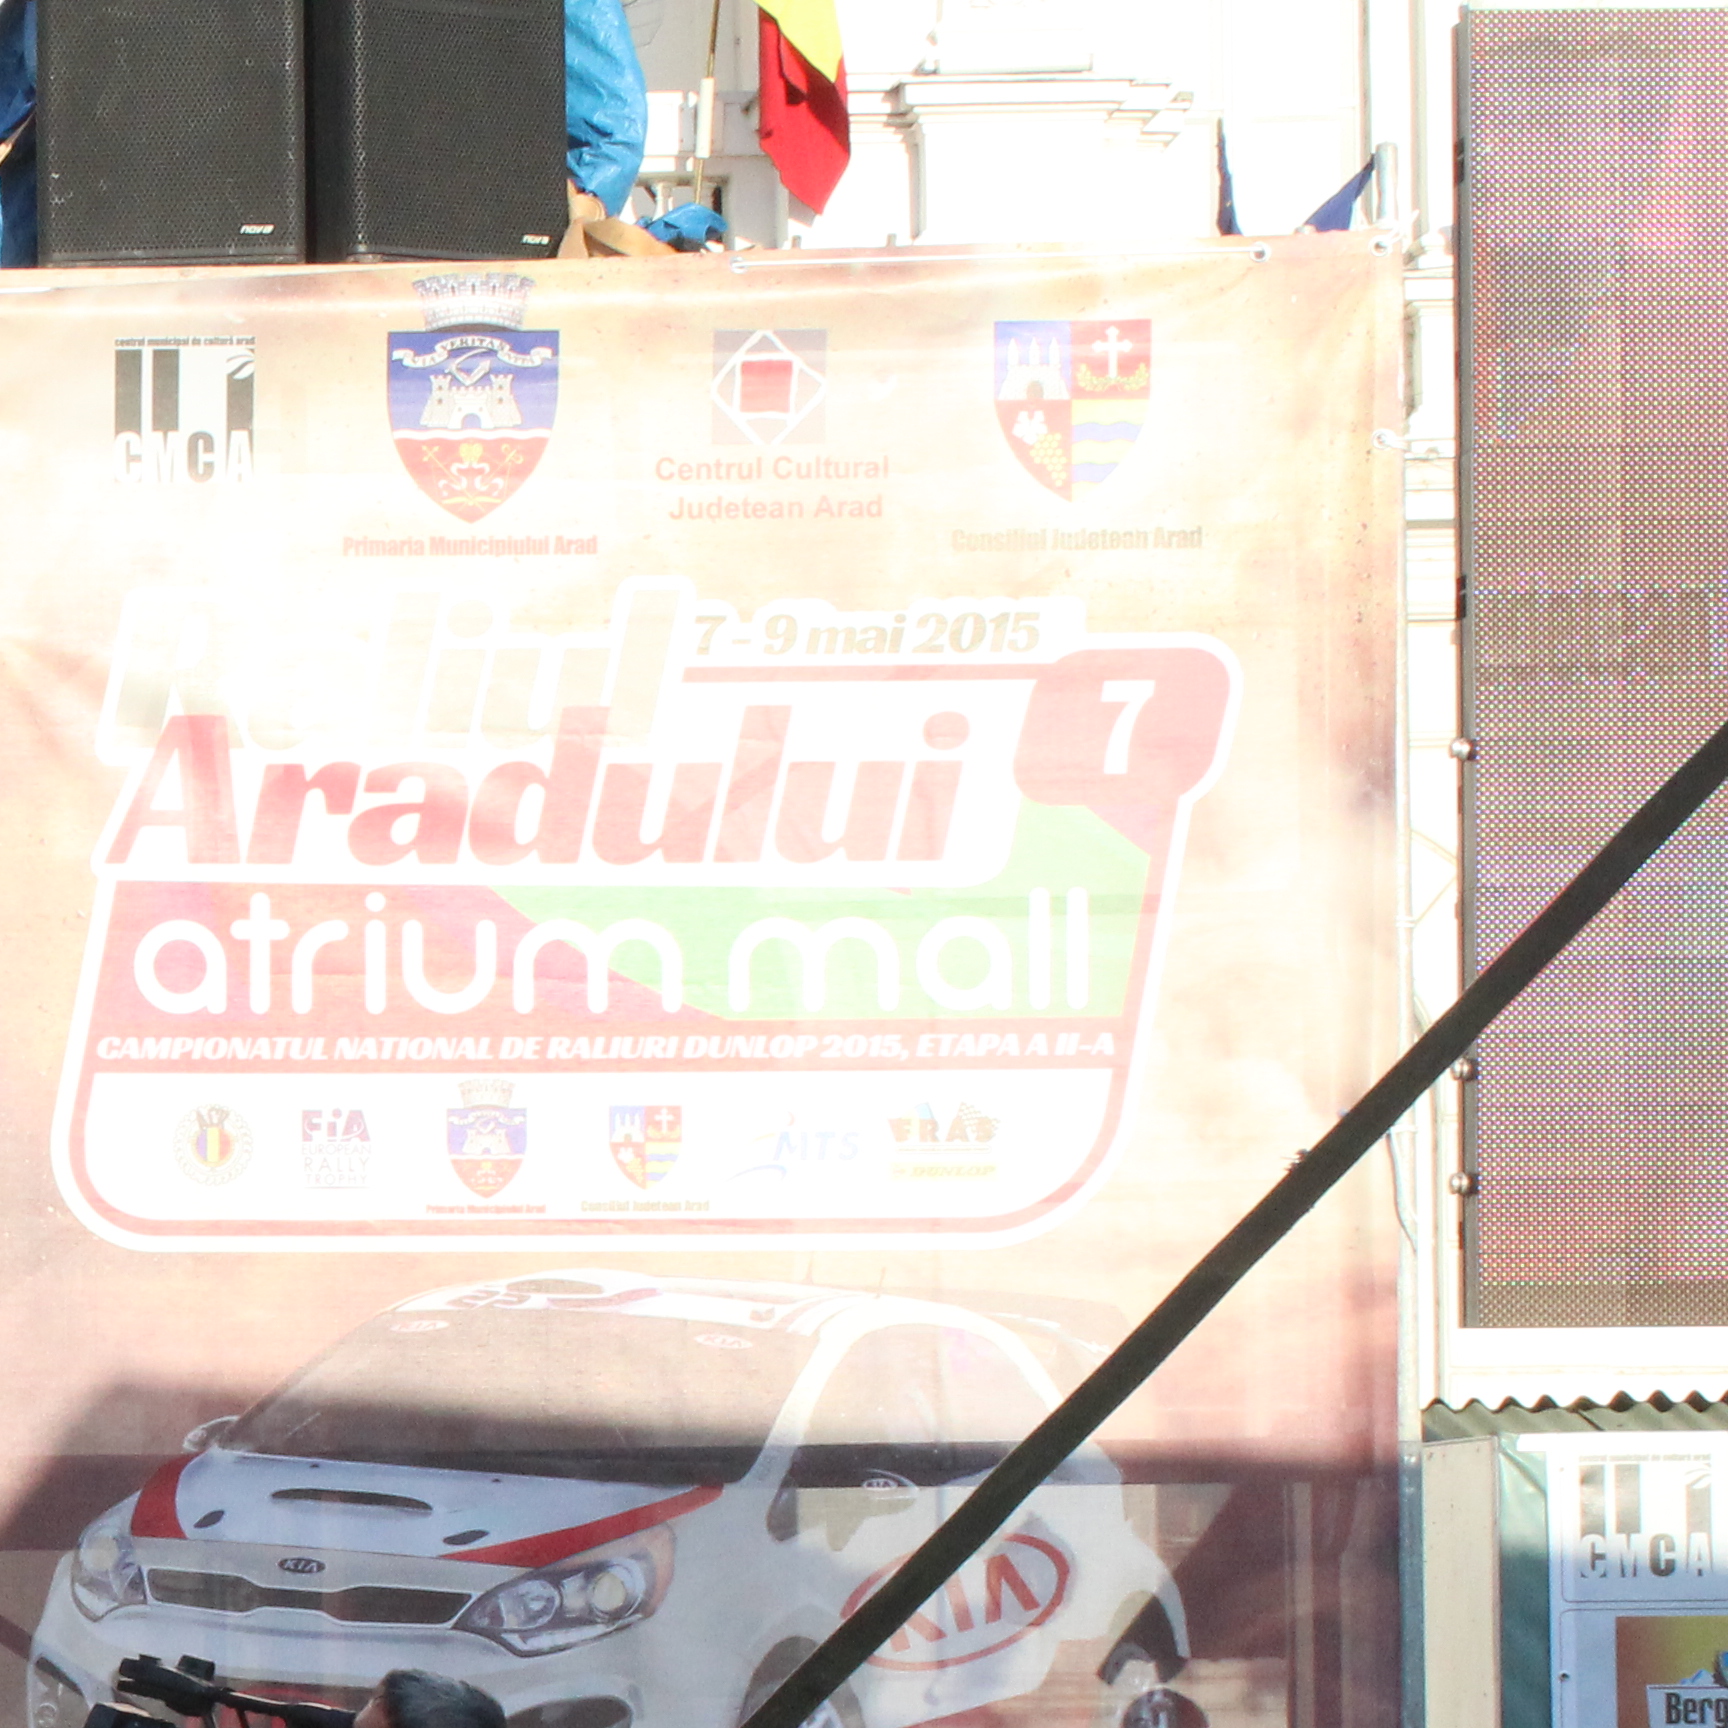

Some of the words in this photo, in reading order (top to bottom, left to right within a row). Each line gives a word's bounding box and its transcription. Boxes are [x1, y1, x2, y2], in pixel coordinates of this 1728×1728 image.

[655, 456, 763, 482] Centrul
[772, 454, 889, 481] Cultural
[814, 494, 883, 519] Arad
[341, 535, 424, 556] Primaria
[428, 535, 551, 558] Municipiului
[553, 534, 598, 555] Arad
[1152, 526, 1202, 549] Arad
[806, 612, 907, 655] mai
[912, 610, 1040, 655] 2015
[104, 704, 970, 866] Aradului
[133, 891, 684, 1015] atrium
[728, 886, 1090, 1013] mall
[96, 1036, 331, 1061] CAMPIONATUL
[334, 1035, 494, 1061] NATIONAL
[497, 1036, 542, 1060] DE
[547, 1035, 680, 1060] RALIURI
[683, 1034, 819, 1060] DUNLOP
[916, 1032, 1021, 1058] ETAPA
